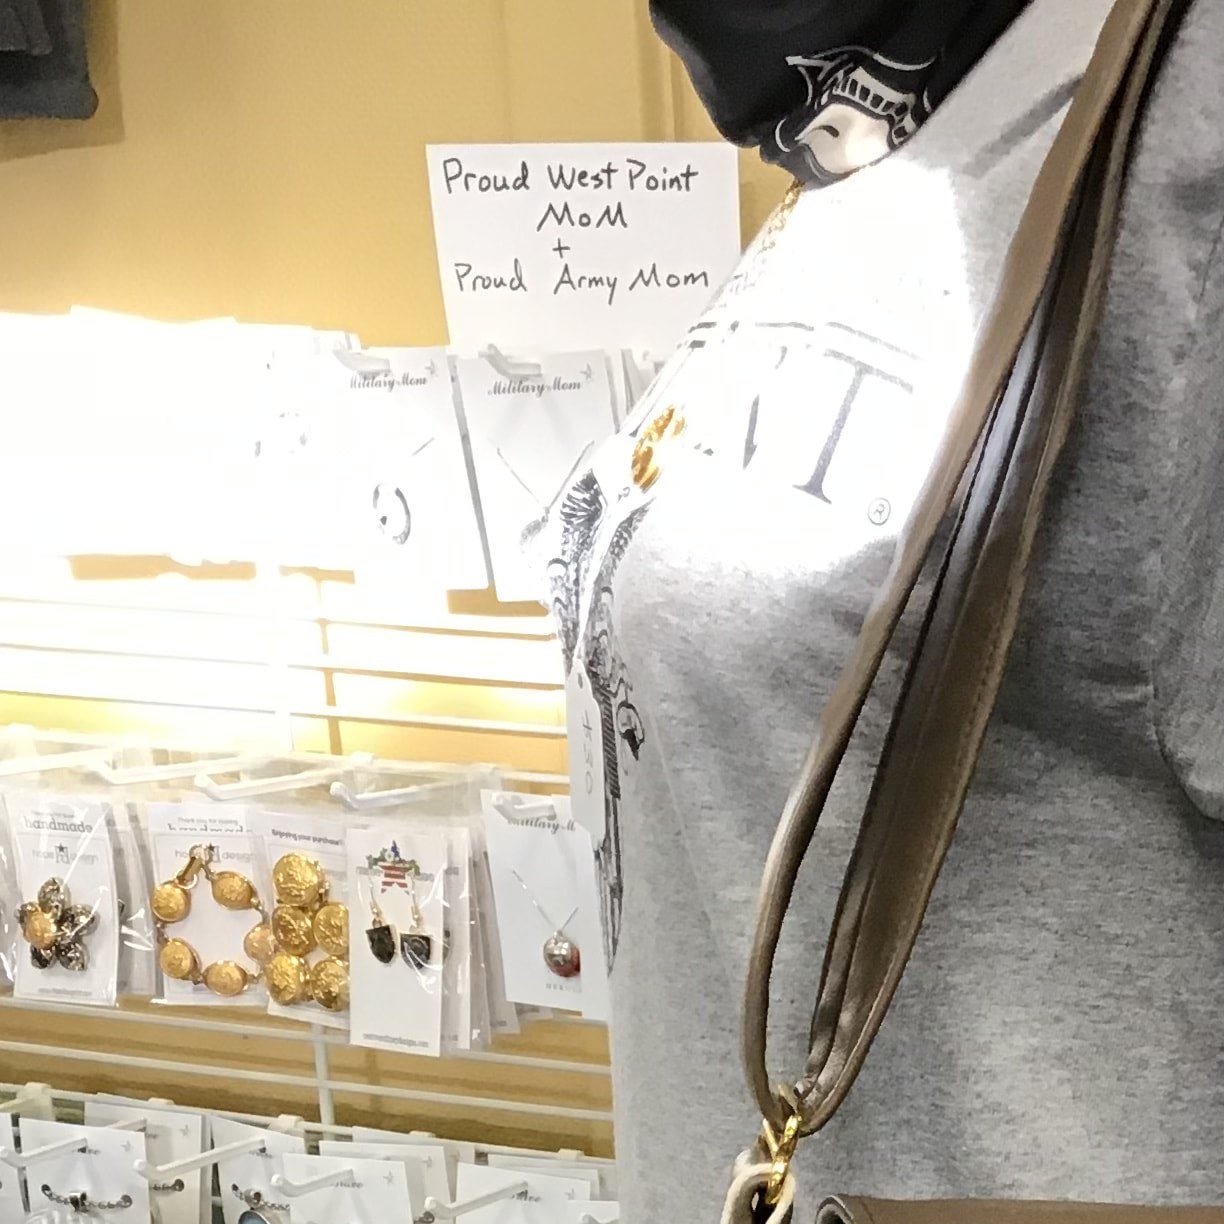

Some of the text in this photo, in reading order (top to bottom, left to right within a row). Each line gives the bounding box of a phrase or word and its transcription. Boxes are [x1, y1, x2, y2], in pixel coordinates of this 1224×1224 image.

[443, 157, 699, 194] Proud West Point
[454, 258, 709, 305] Proud Army Mom
[349, 372, 428, 392] Military Mom
[487, 376, 581, 398] Military Mom
